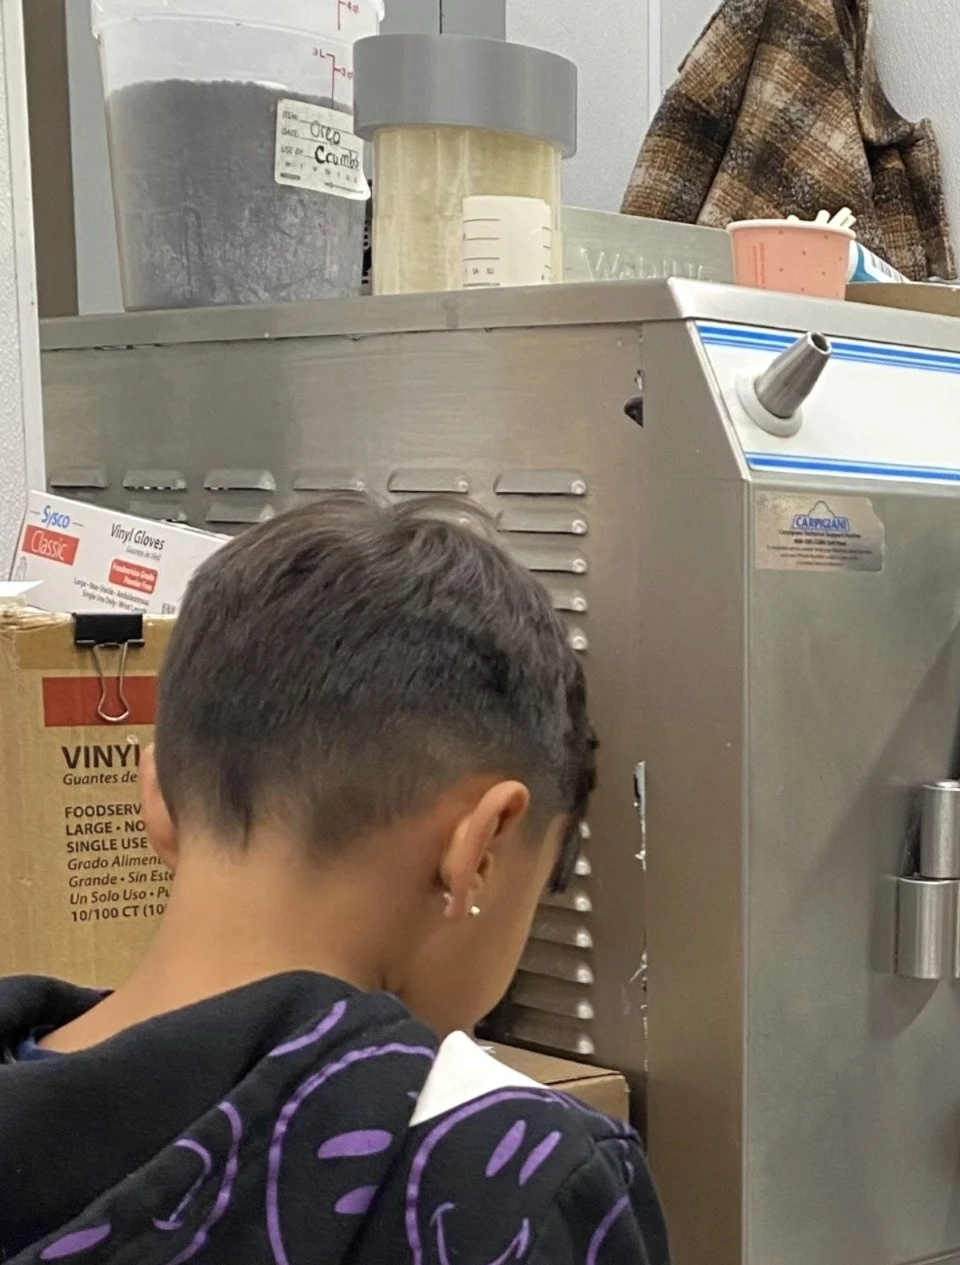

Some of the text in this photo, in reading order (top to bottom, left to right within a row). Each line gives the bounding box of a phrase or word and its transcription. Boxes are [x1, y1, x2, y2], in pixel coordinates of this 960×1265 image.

[310, 120, 341, 145] Oreo
[41, 504, 70, 528] Sysco
[110, 522, 165, 550] Vinyl Gloves
[30, 529, 68, 561] Classic
[63, 771, 137, 786] Guantes de
[66, 821, 113, 836] LARGE
[67, 836, 148, 853] SINGLE USE
[67, 856, 109, 871] Grado
[69, 873, 118, 888] Grande
[128, 871, 148, 883] Sin
[70, 892, 88, 905] Un
[91, 889, 120, 904] Solo
[123, 888, 147, 901] Uso
[72, 907, 119, 922] 10/100
[122, 905, 140, 918] CT
